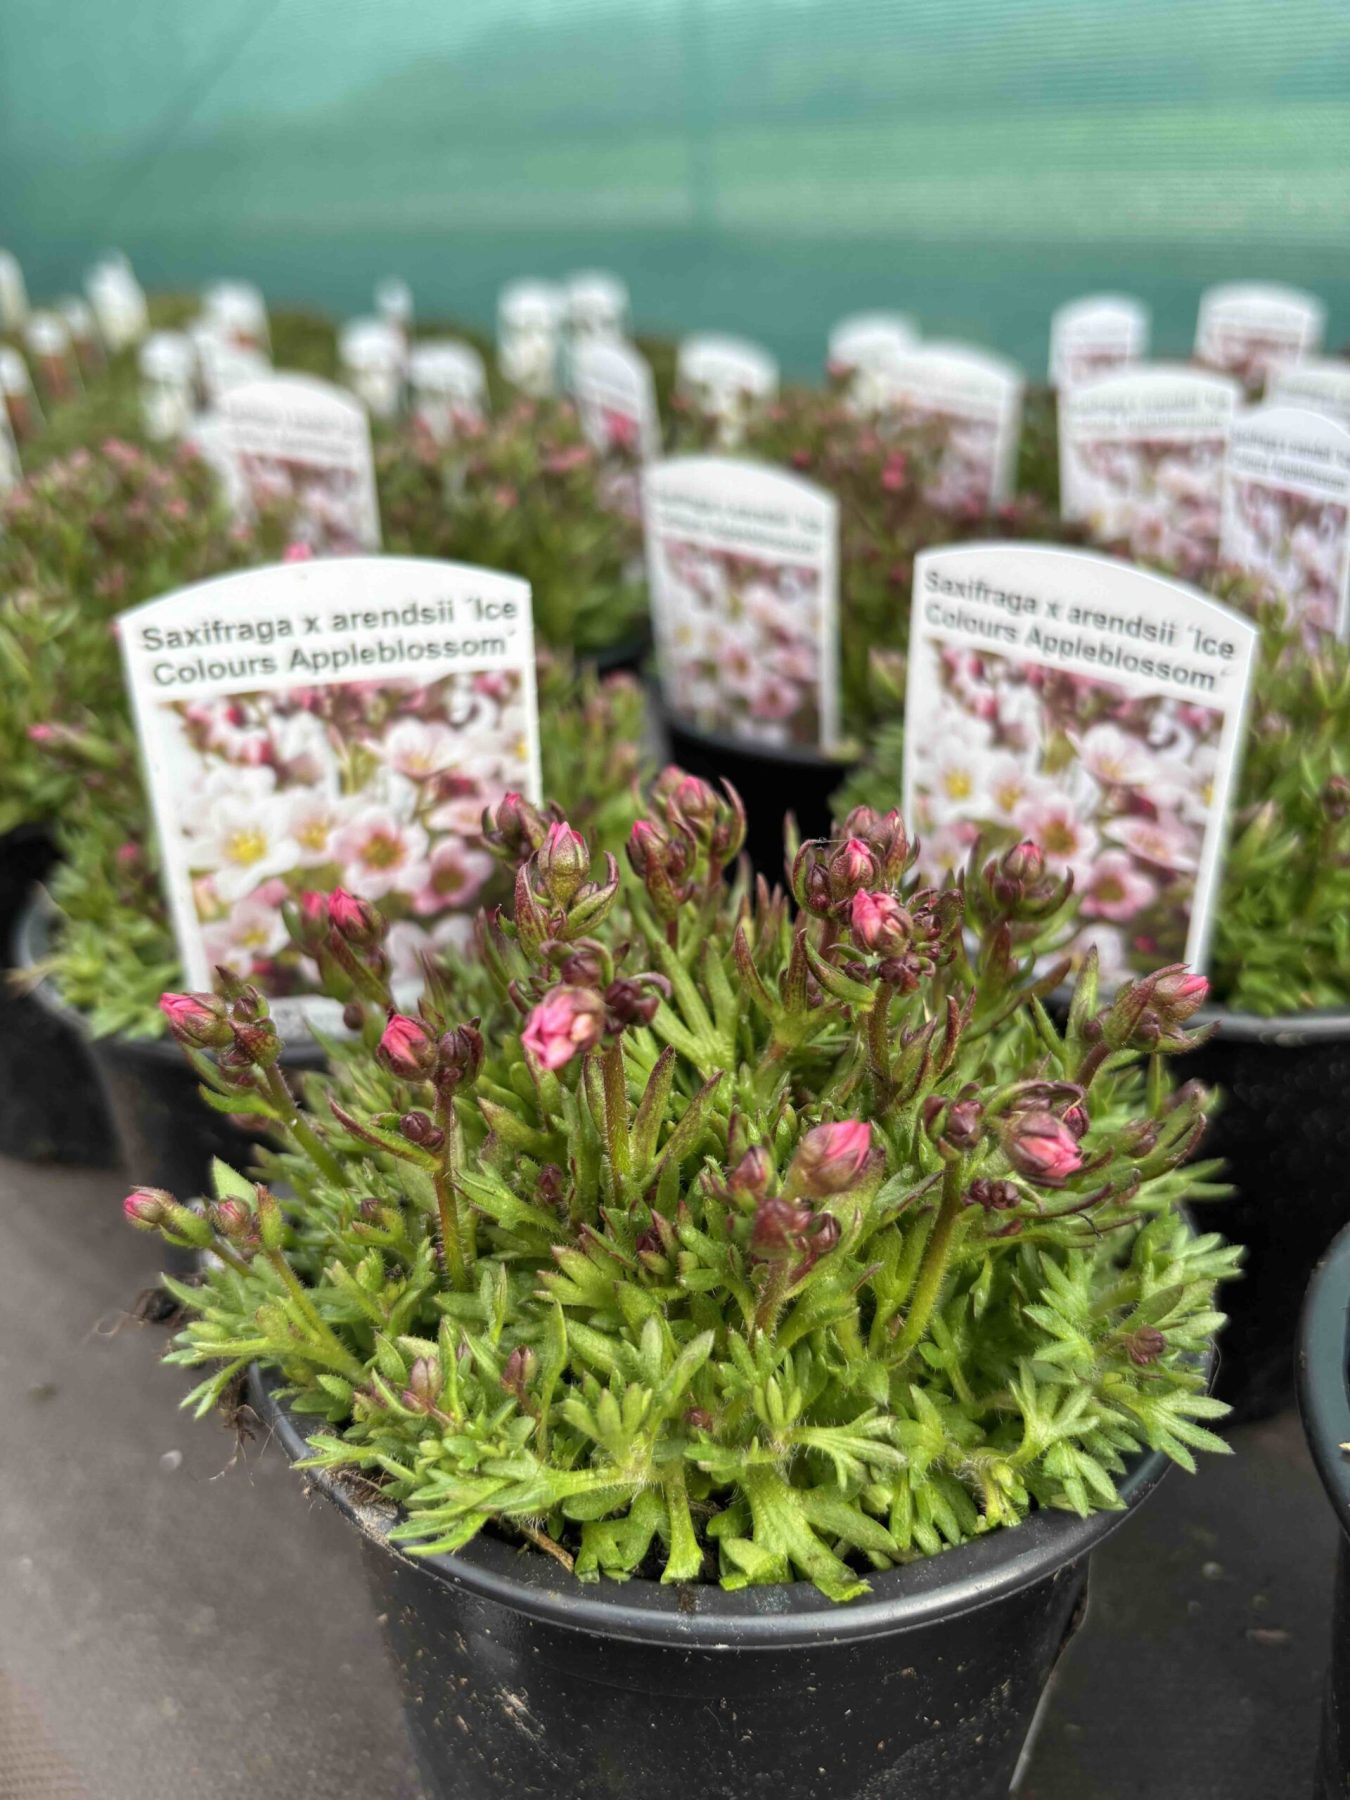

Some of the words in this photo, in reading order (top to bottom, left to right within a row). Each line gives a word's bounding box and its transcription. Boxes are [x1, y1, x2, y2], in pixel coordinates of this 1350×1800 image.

[142, 619, 292, 651] Saxifraga
[304, 616, 320, 634] x
[333, 598, 454, 631] arendsii
[924, 571, 1036, 615] Saxifraga
[1045, 601, 1062, 620] x
[1067, 606, 1175, 646] arendsii
[925, 602, 1018, 644] Colours
[152, 657, 278, 686] Colours
